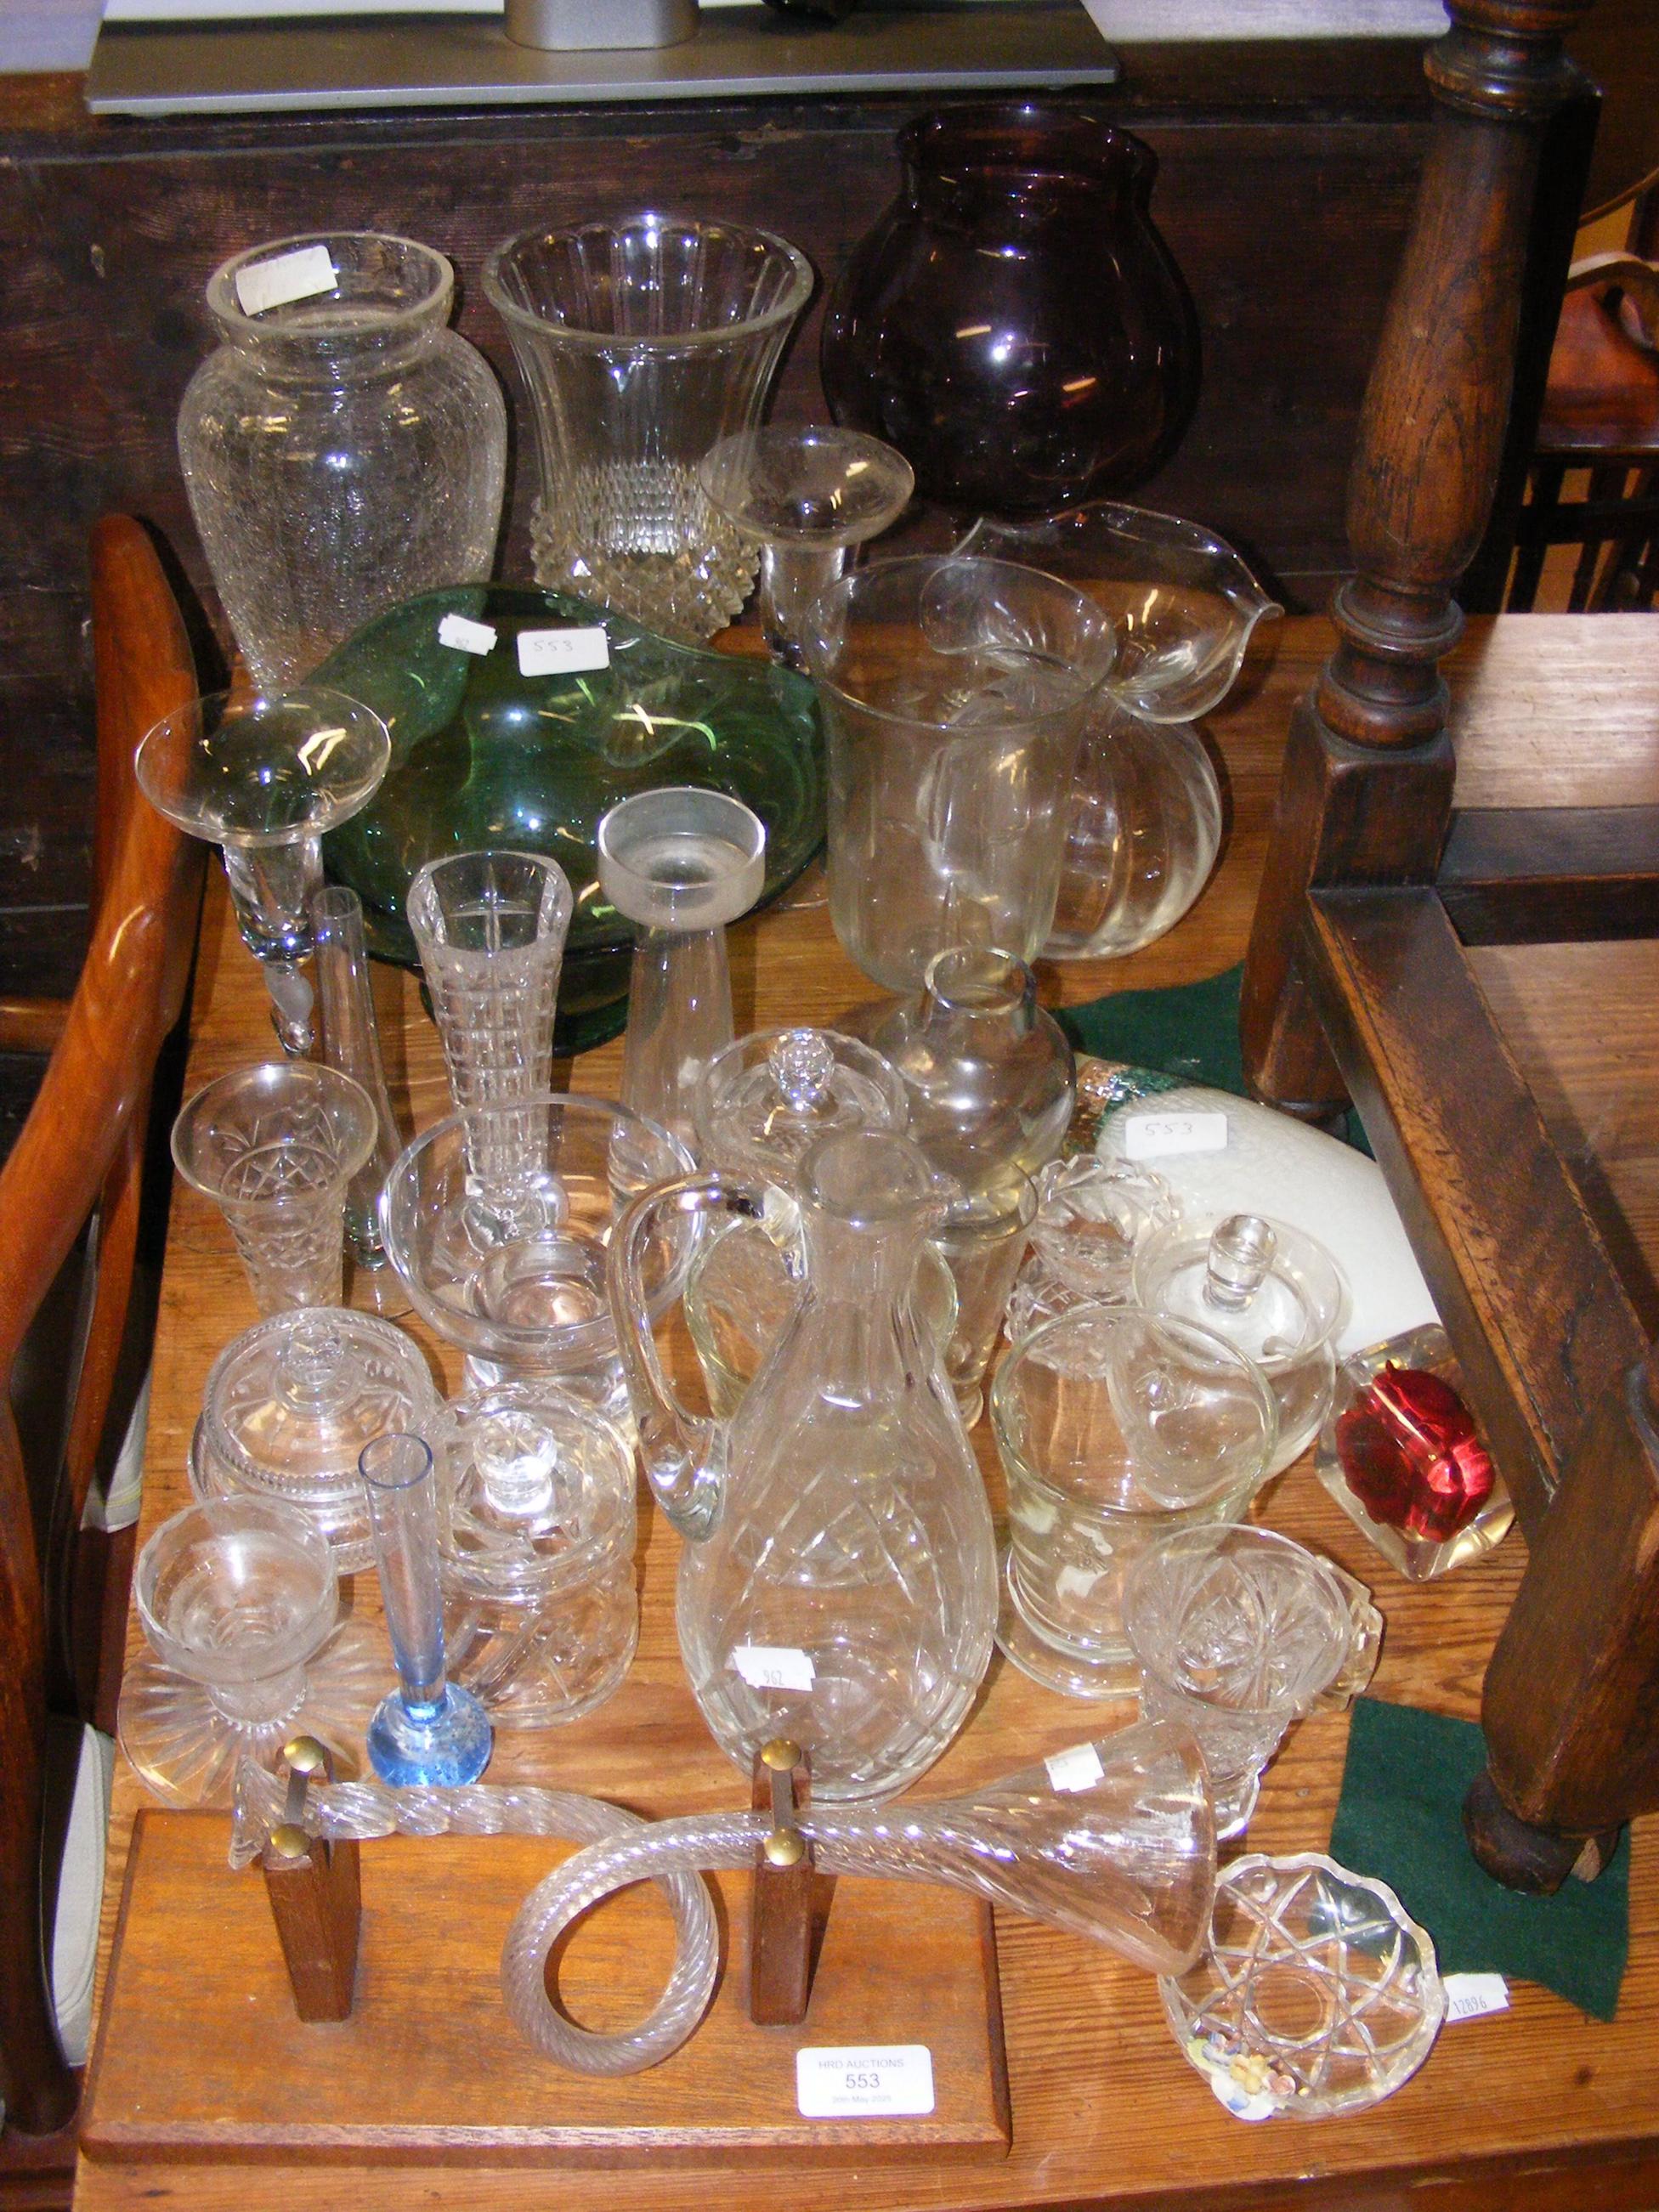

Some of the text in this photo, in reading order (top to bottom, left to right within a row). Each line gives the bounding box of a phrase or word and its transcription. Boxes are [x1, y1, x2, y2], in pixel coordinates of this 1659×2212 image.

[534, 639, 573, 653] 553
[1144, 1122, 1193, 1136] 553
[1452, 1994, 1487, 2015] 12896
[818, 2058, 904, 2069] HRD AUCTIONS
[846, 2073, 880, 2089] 553
